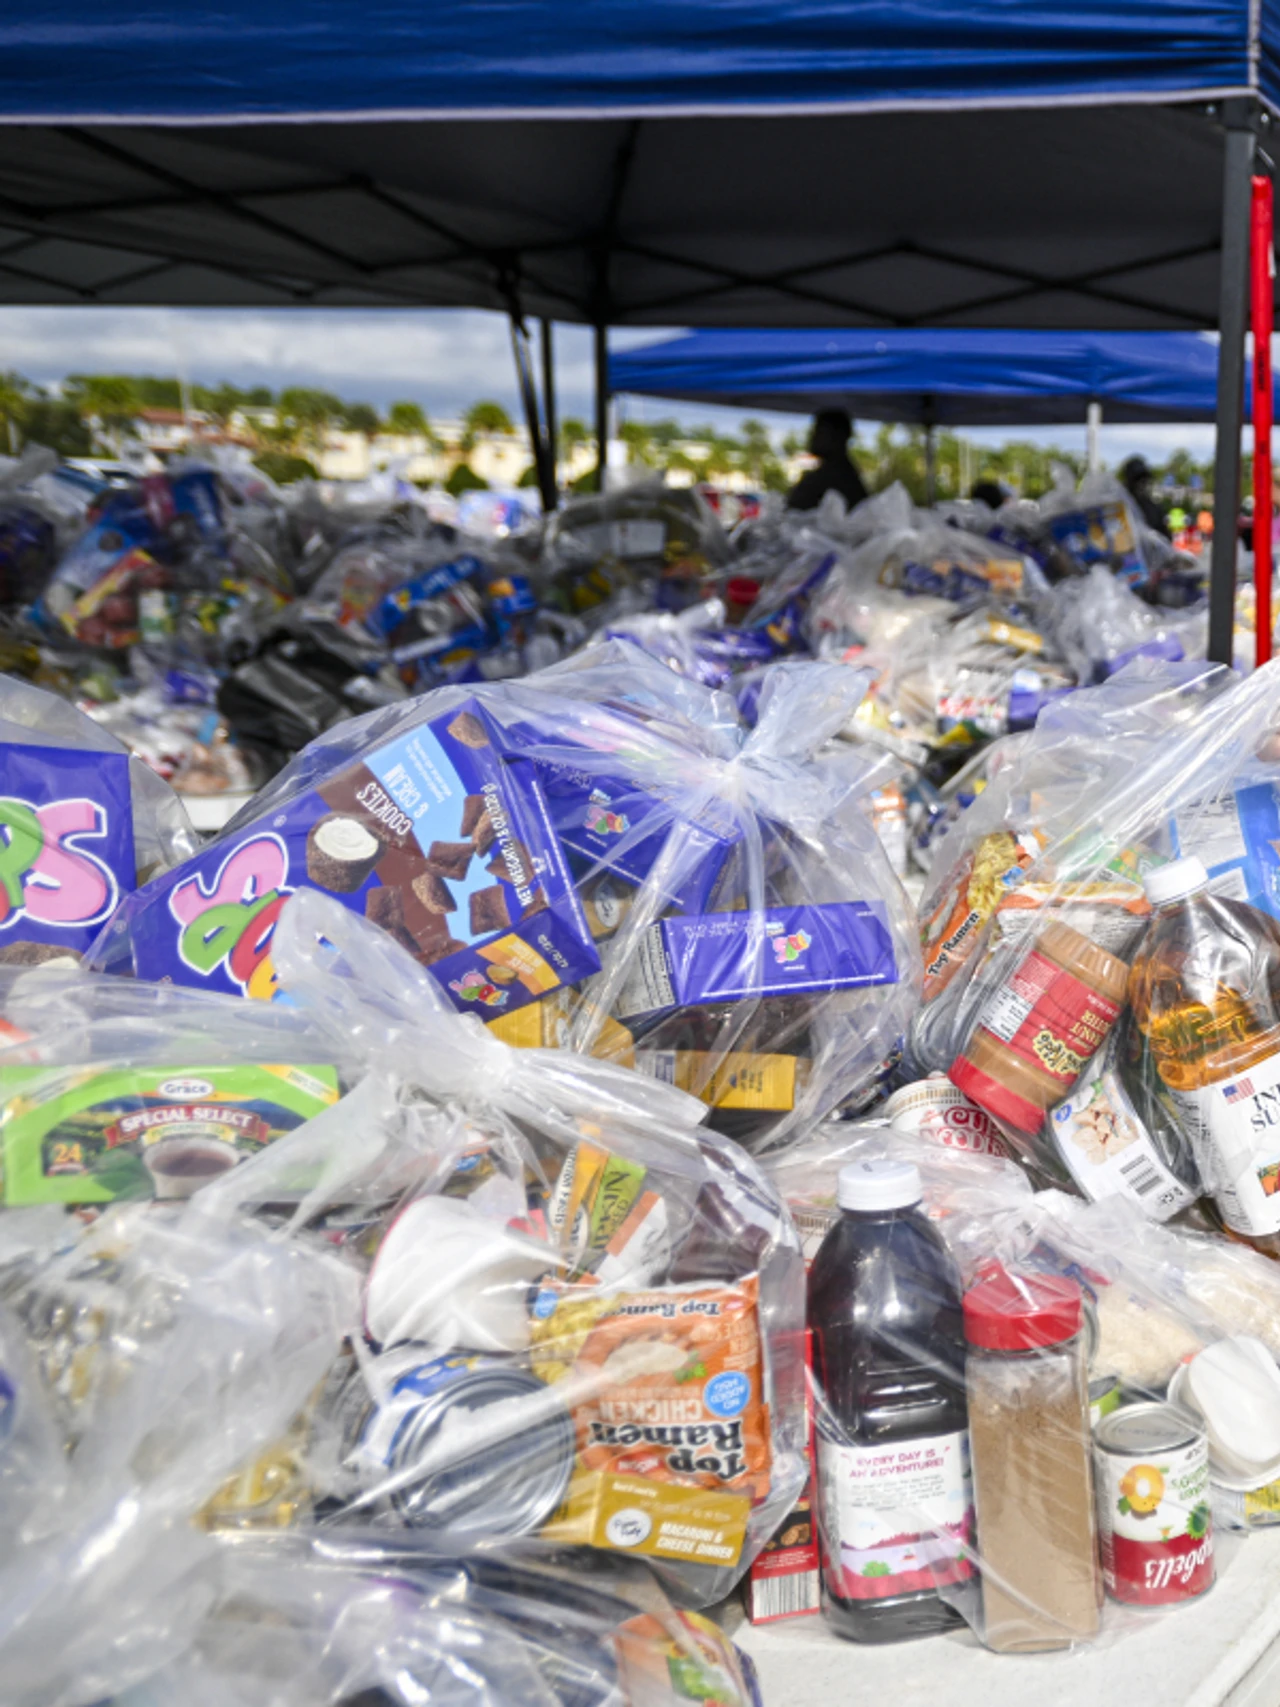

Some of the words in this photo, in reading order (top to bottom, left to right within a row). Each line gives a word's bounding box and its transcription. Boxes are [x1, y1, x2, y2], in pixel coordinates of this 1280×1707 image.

[382, 762, 422, 808] CREAM
[356, 782, 413, 835] COOKIES
[515, 884, 533, 907] NET
[928, 952, 949, 975] Top
[943, 912, 979, 953] Ramen
[164, 1079, 209, 1095] Grace
[119, 1107, 191, 1132] SPECIAL
[192, 1107, 252, 1129] SELECT
[53, 1143, 82, 1163] 24
[681, 1301, 720, 1316] Top
[602, 1401, 701, 1421] CHICKEN
[590, 1420, 744, 1452] Ramen
[667, 1449, 748, 1481] Top
[849, 1469, 866, 1479] AN
[870, 1458, 944, 1478] ADVENTURE!
[856, 1454, 895, 1468] EVERY
[899, 1450, 921, 1462] DAY
[926, 1449, 936, 1458] IS
[660, 1521, 714, 1542] MACARONI
[656, 1536, 697, 1554] CHEESE
[695, 1543, 735, 1559] DINNER
[1144, 1535, 1214, 1590] pbell's
